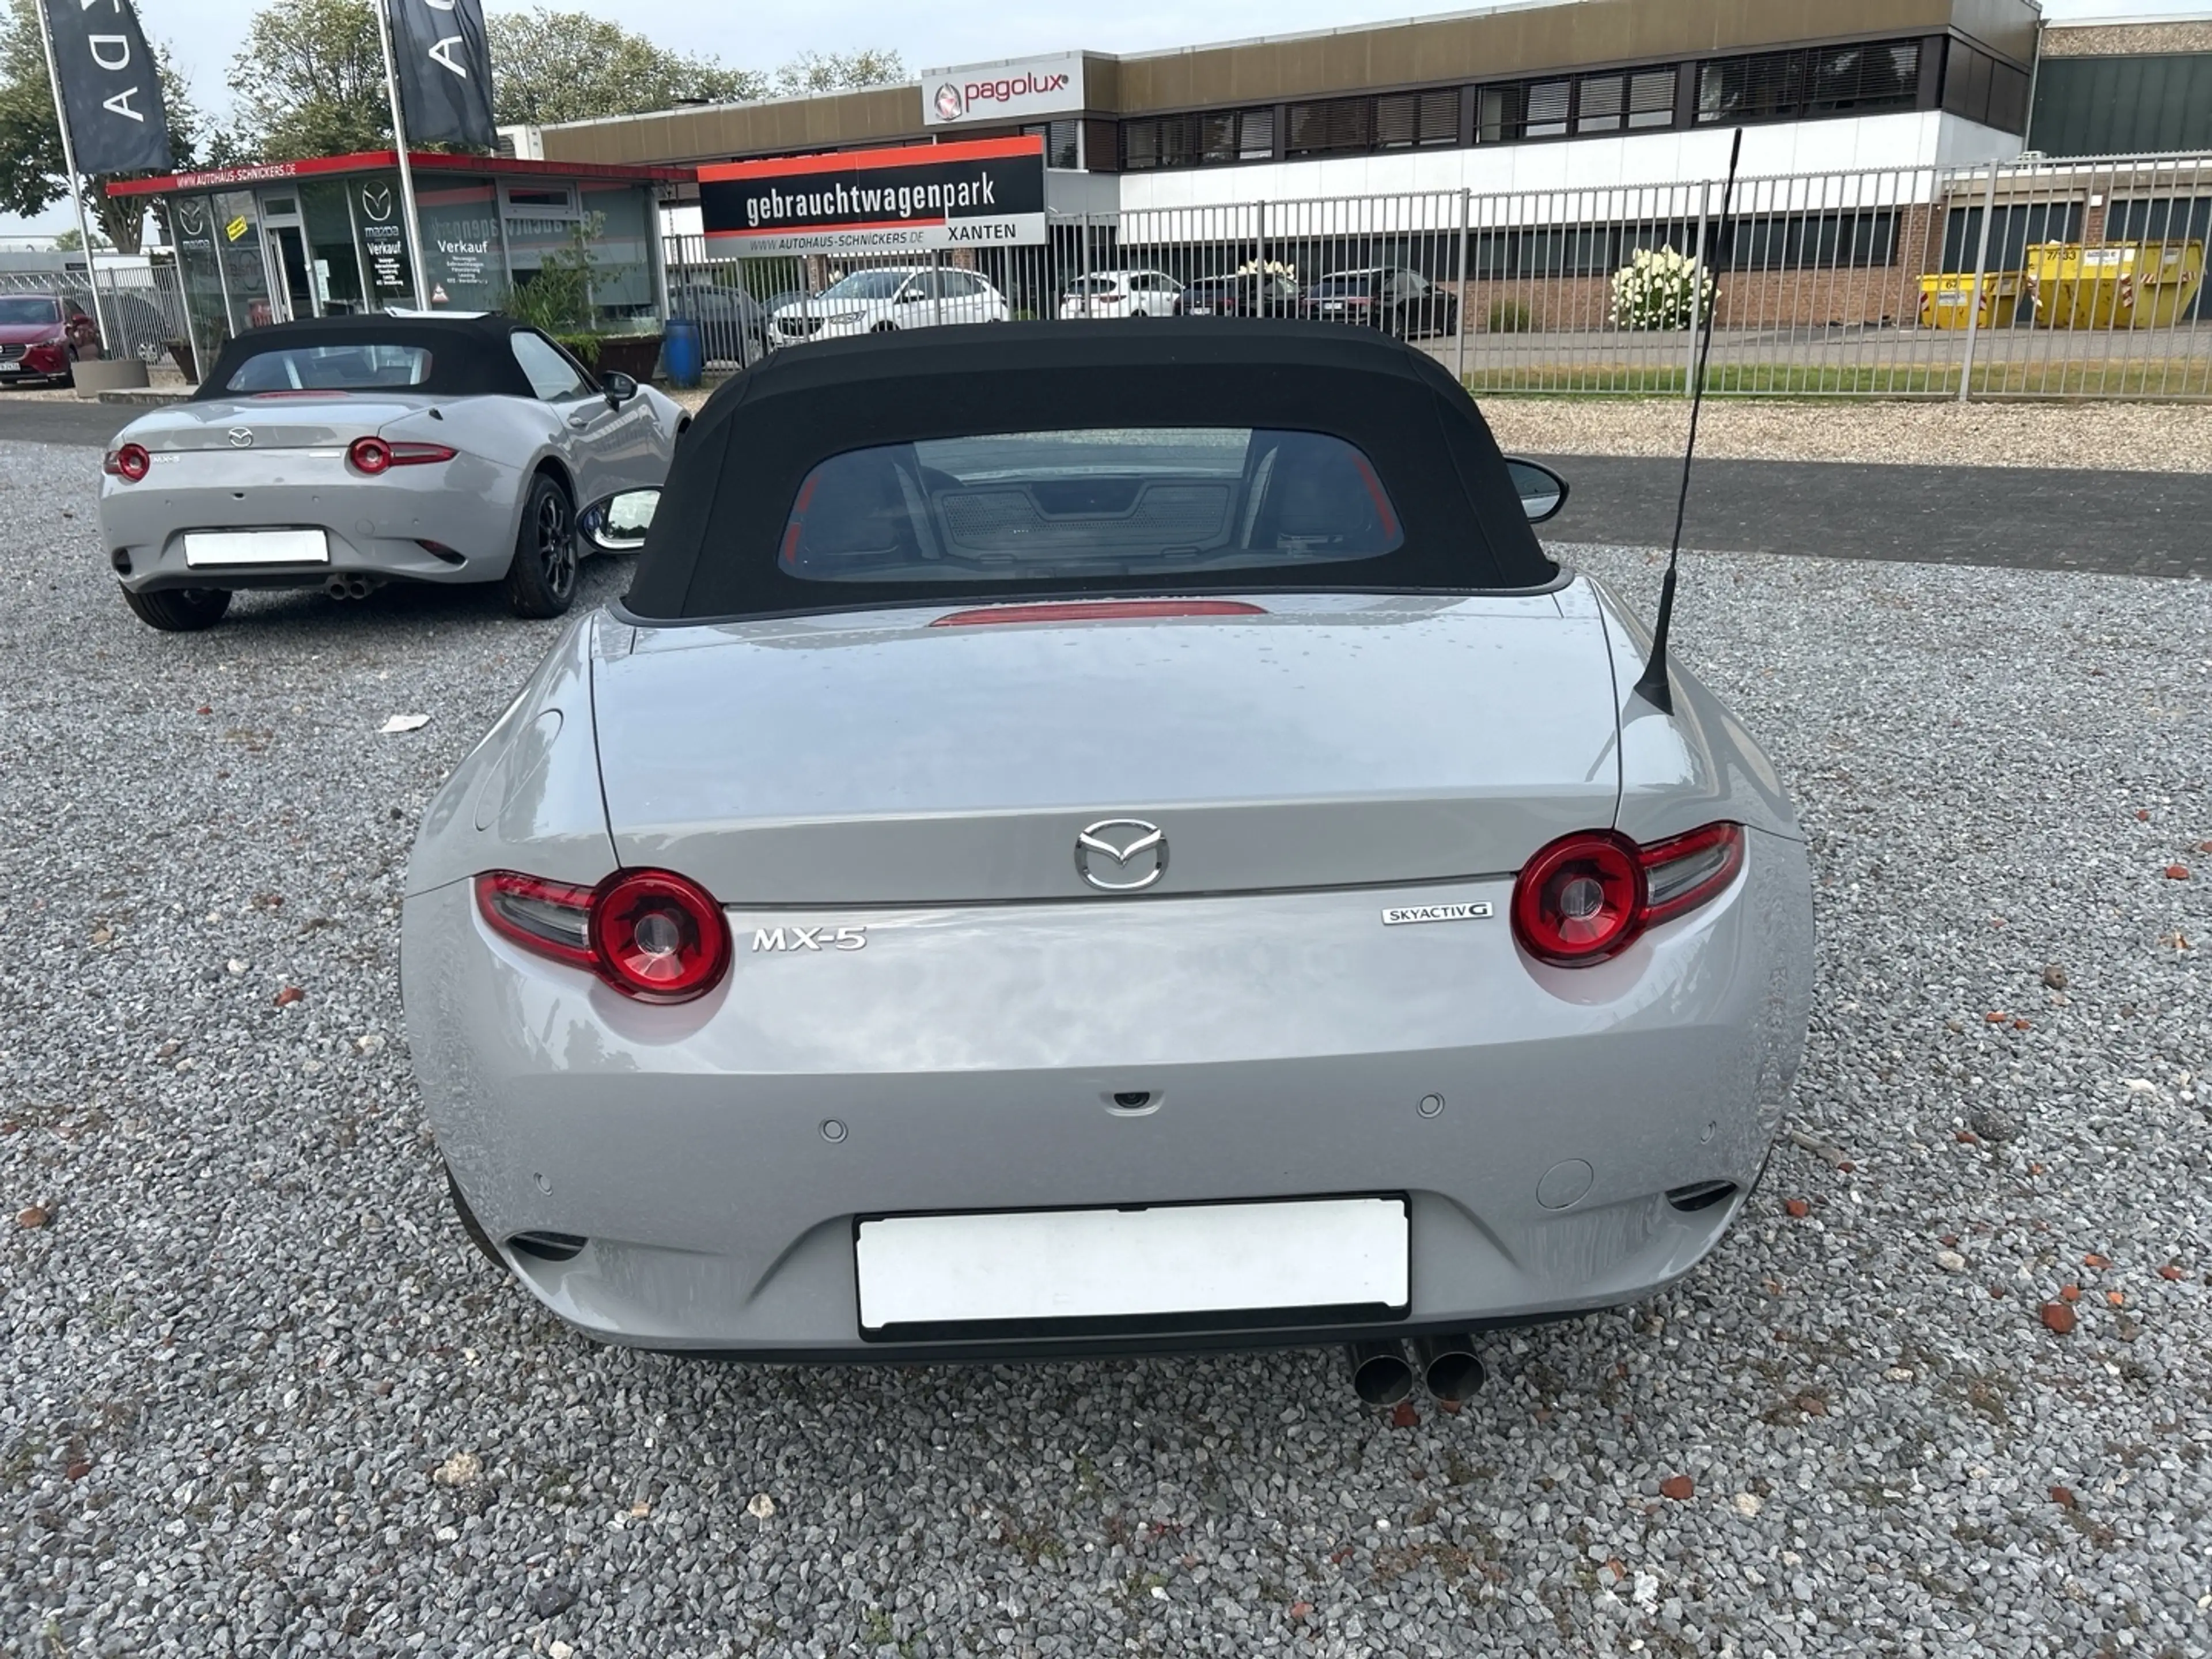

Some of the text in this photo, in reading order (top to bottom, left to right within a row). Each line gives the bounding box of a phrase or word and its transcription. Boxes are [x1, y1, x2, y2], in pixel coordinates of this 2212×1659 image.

[747, 172, 995, 227] gebrauchtwagenpark
[948, 224, 1016, 240] XANTEN
[367, 240, 402, 255] Verkauf
[437, 240, 488, 253] Verkauf
[752, 926, 867, 953] MX-5
